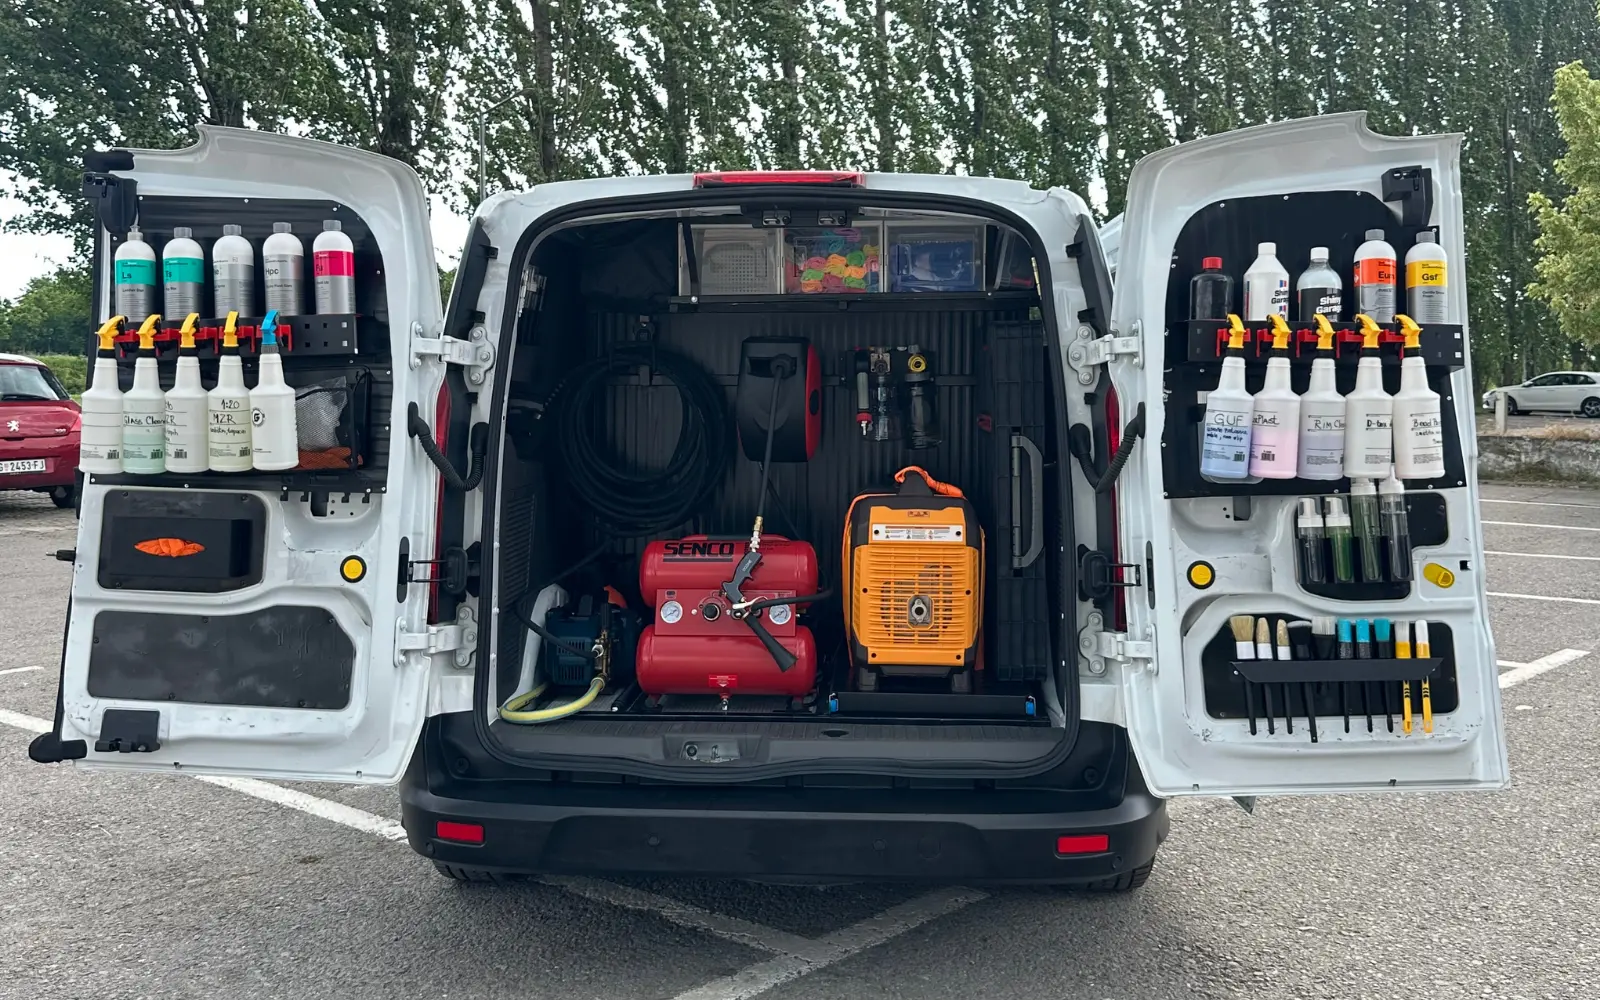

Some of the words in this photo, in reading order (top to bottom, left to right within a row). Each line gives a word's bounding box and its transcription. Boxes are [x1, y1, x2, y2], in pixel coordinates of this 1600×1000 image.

[265, 268, 279, 276] Hpc
[1422, 273, 1438, 281] Gsf
[1315, 305, 1343, 314] Garag
[221, 399, 240, 410] 1:20
[165, 415, 177, 426] ZR
[213, 413, 237, 424] MZR
[1214, 413, 1243, 426] GUF
[664, 542, 734, 557] SENCO
